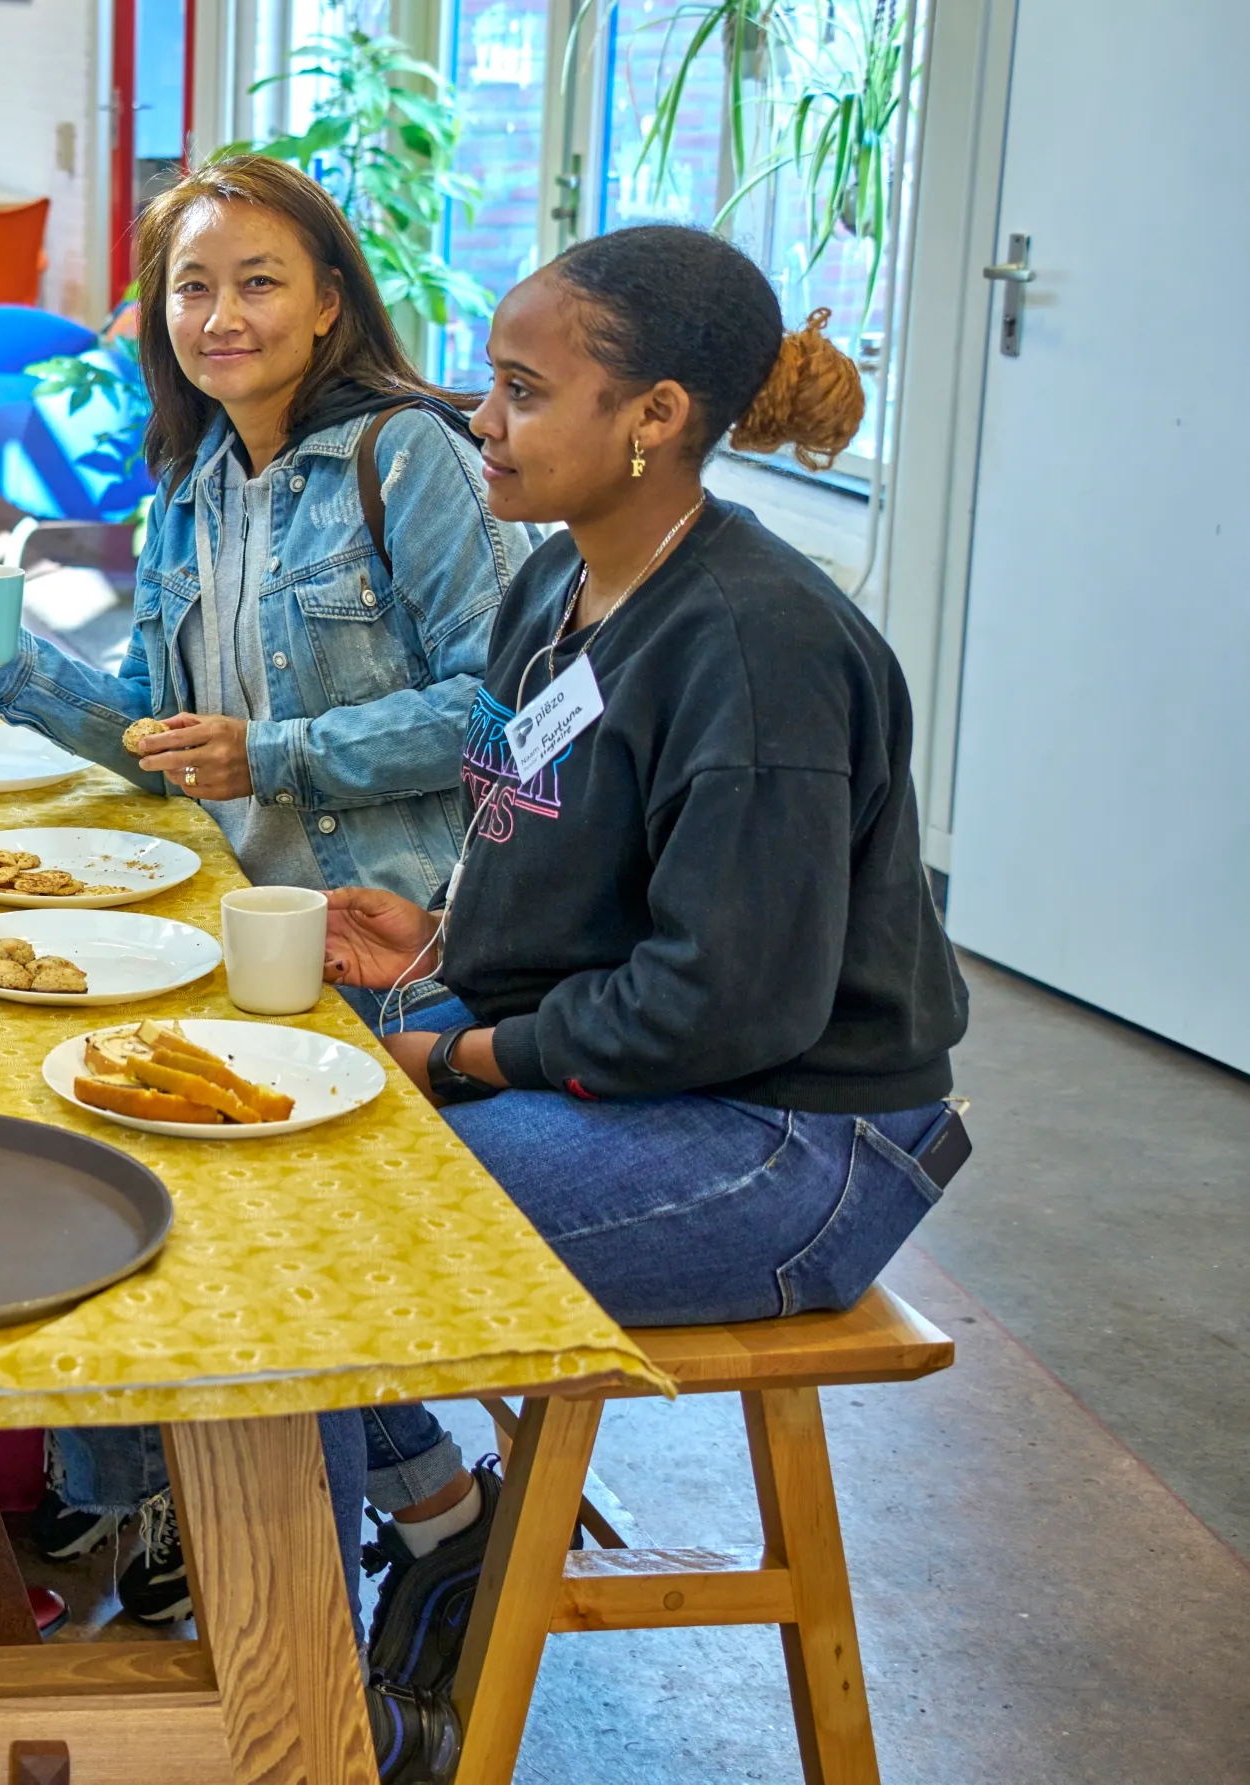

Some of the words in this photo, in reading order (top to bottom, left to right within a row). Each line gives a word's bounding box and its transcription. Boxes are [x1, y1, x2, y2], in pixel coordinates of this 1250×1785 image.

[631, 459, 646, 477] F
[535, 692, 564, 727] piëzo
[521, 746, 540, 765] Naam
